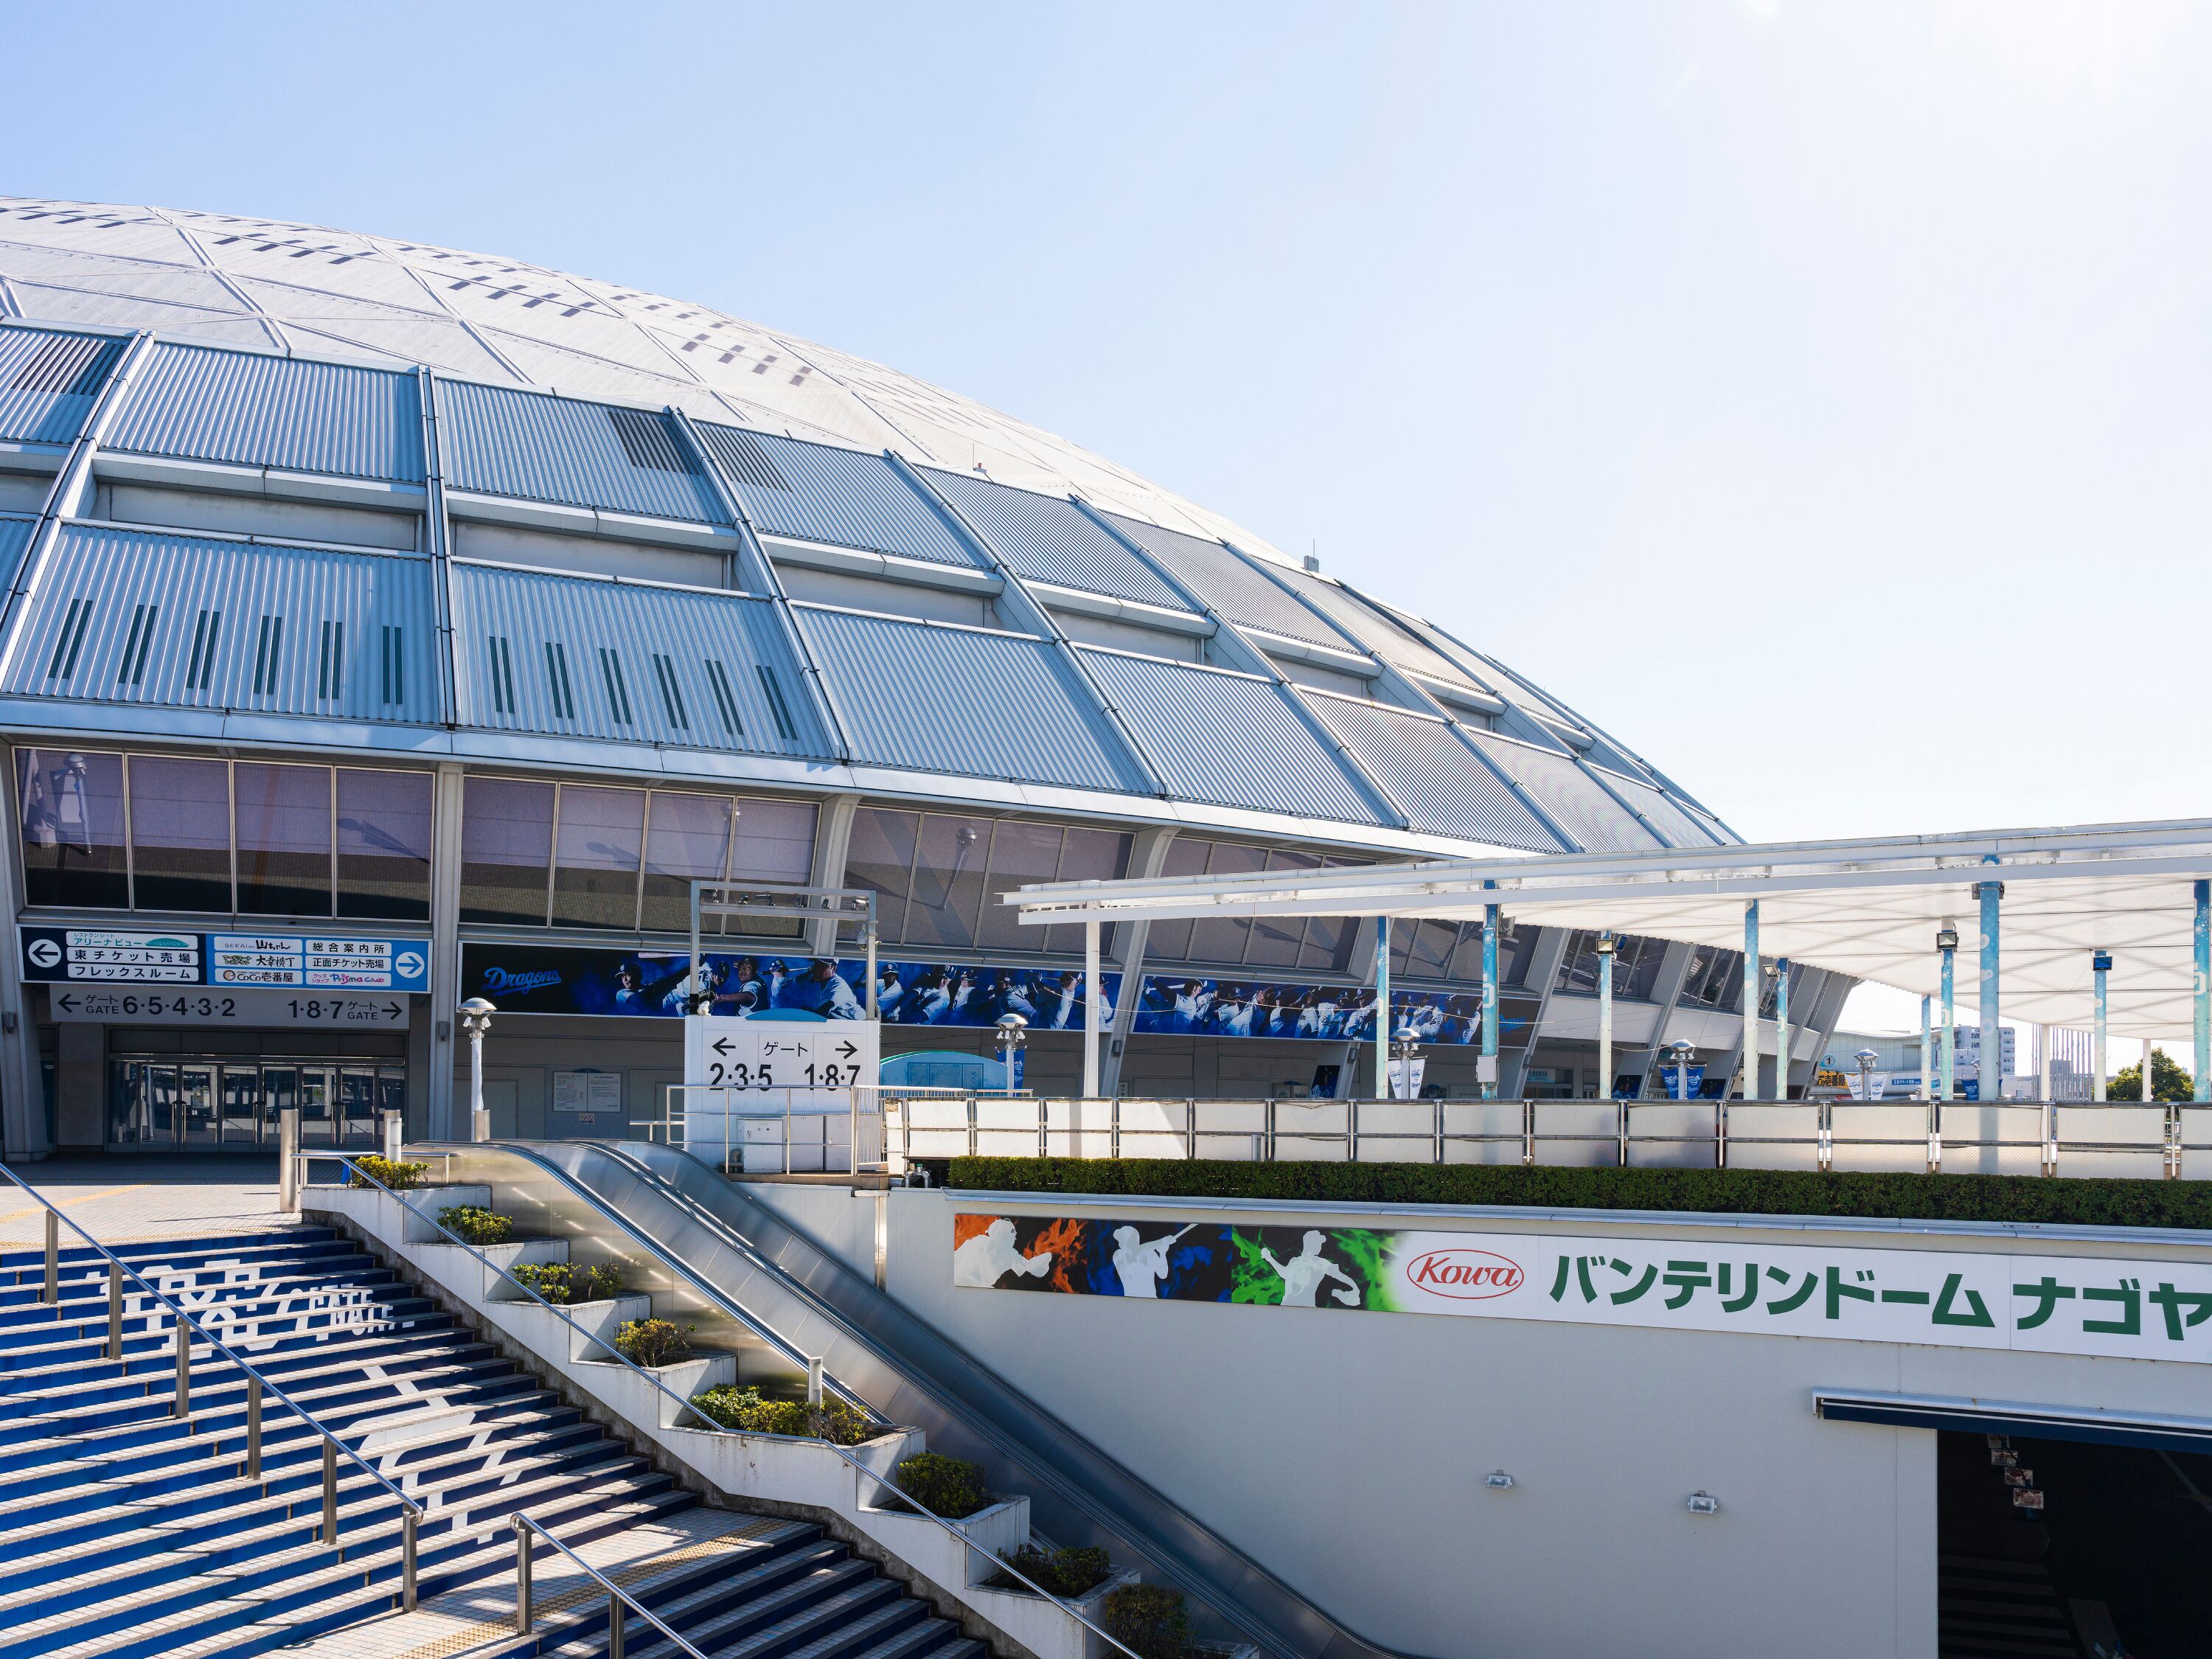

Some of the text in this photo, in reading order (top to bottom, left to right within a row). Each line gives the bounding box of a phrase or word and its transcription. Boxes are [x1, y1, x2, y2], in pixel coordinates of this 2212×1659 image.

[74, 938, 143, 947] アリーナビュー
[313, 942, 385, 954] 総合案内所
[74, 949, 191, 964] 東チケット売場
[256, 955, 295, 967] 大幸横丁
[313, 958, 384, 969] 正面チケット売場
[74, 966, 191, 979] フレックスルーム
[483, 967, 562, 996] Dragons
[86, 994, 119, 1005] ゲート
[86, 1005, 119, 1015] GATE
[347, 1001, 378, 1011] ゲート
[347, 1012, 378, 1020] GATE
[763, 1041, 808, 1057] ゲート
[1416, 1256, 1518, 1287] Kowa
[1549, 1256, 2212, 1340] バンテリンドーム ナゴヤ
